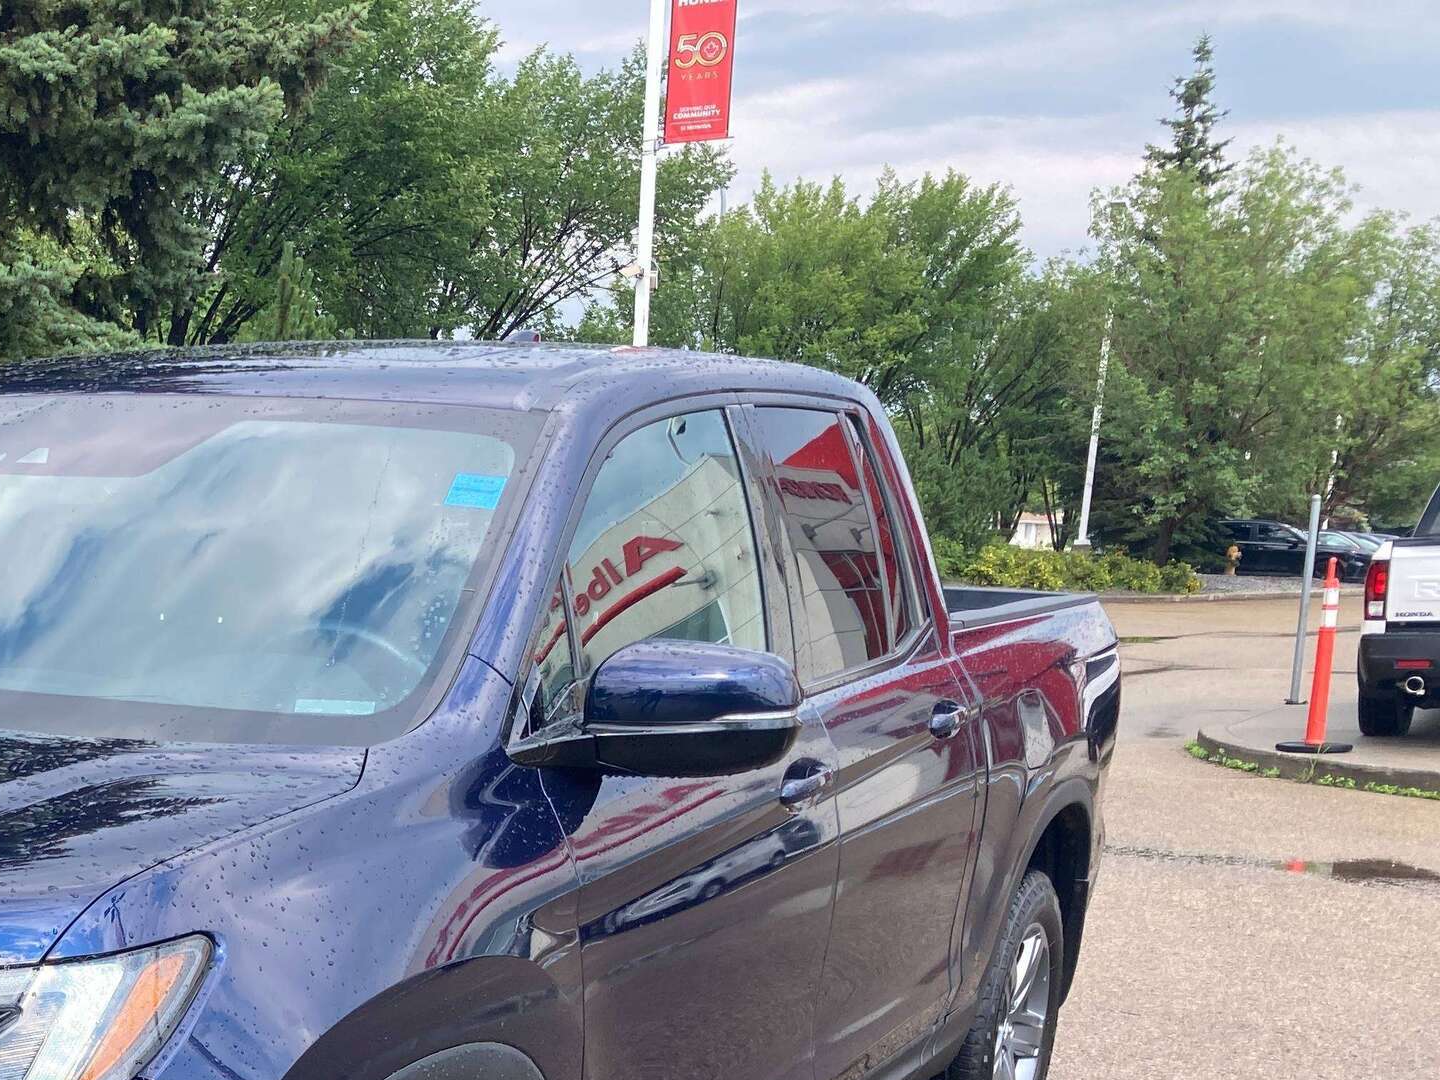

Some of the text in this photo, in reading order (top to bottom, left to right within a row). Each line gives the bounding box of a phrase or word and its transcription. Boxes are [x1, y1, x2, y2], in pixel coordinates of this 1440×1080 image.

[674, 31, 728, 69] 50
[680, 71, 720, 81] YEARS
[672, 109, 721, 120] COMMUNITY
